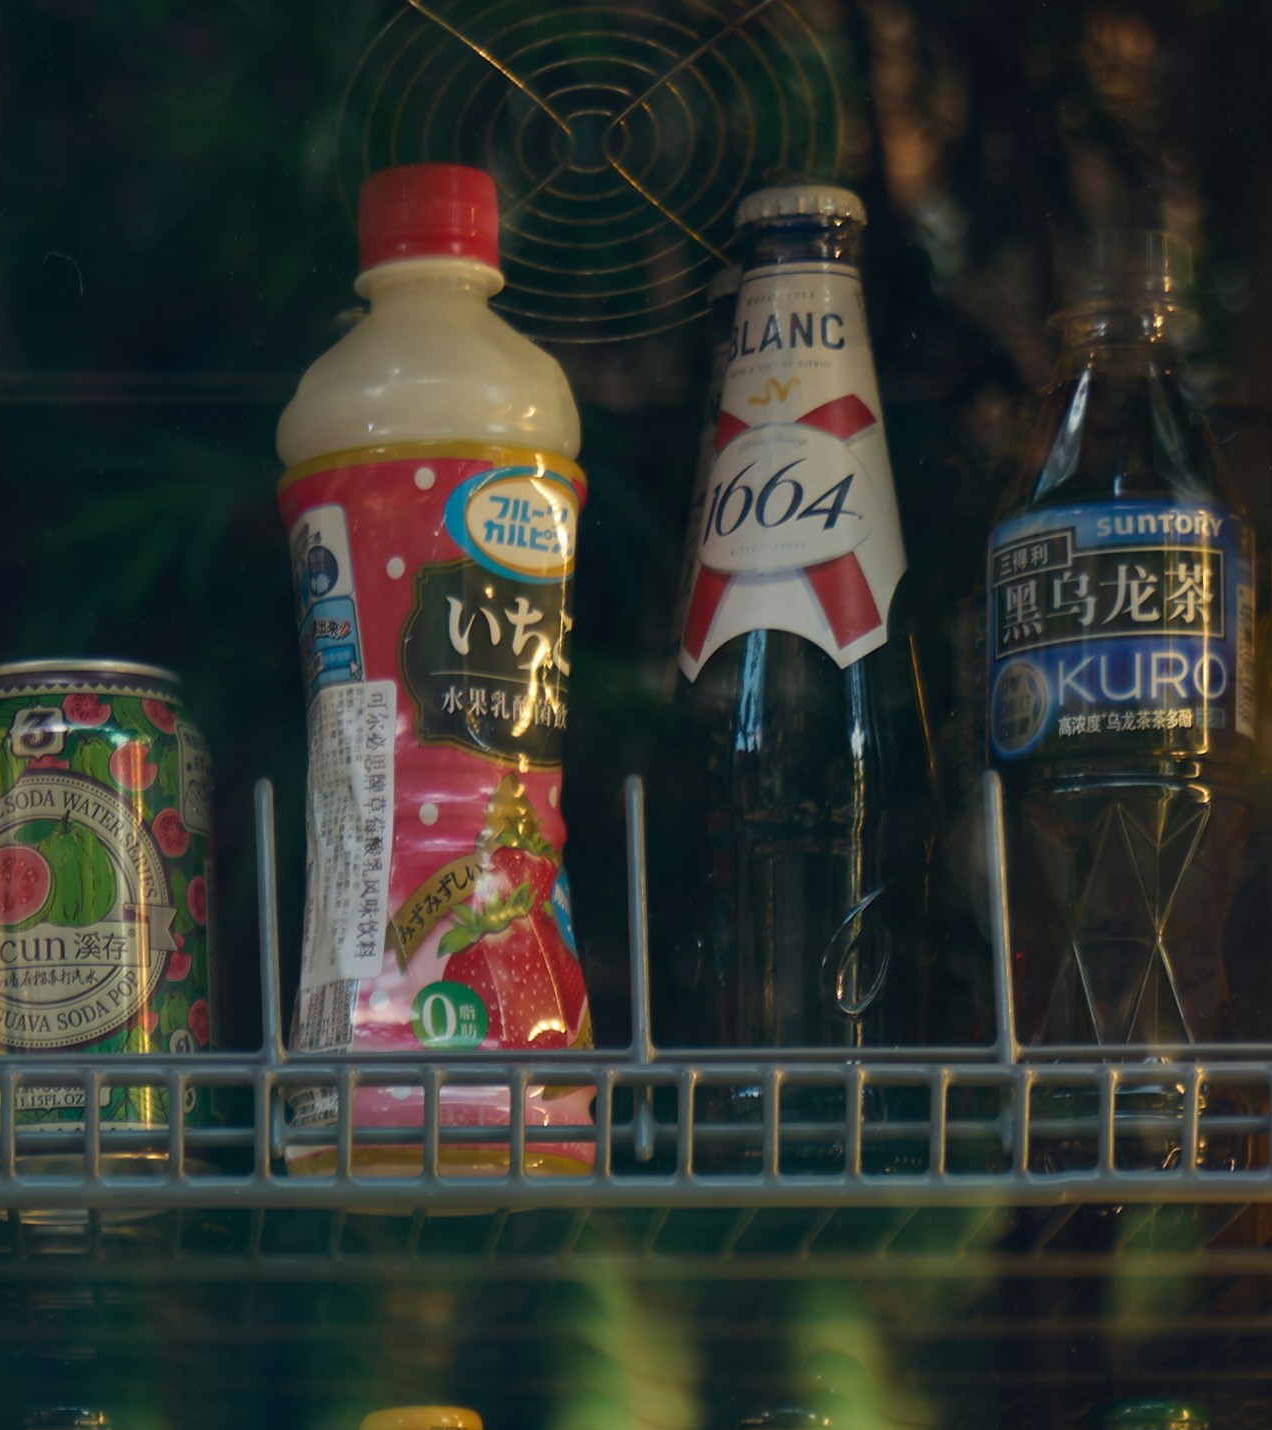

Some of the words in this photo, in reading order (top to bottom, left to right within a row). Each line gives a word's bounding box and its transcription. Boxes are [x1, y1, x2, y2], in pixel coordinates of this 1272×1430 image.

[729, 311, 846, 363] BLANC
[701, 456, 864, 547] 1664
[1096, 511, 1224, 538] SUNTORY
[999, 543, 1049, 577] 三得利
[1003, 562, 1216, 645] 黑乌龙茶
[1057, 651, 1228, 706] KURO
[62, 790, 126, 838] WATER
[74, 933, 129, 961] 溪存
[56, 1000, 109, 1033] SODA
[109, 970, 141, 1009] POP
[458, 1003, 478, 1041] 脂肪
